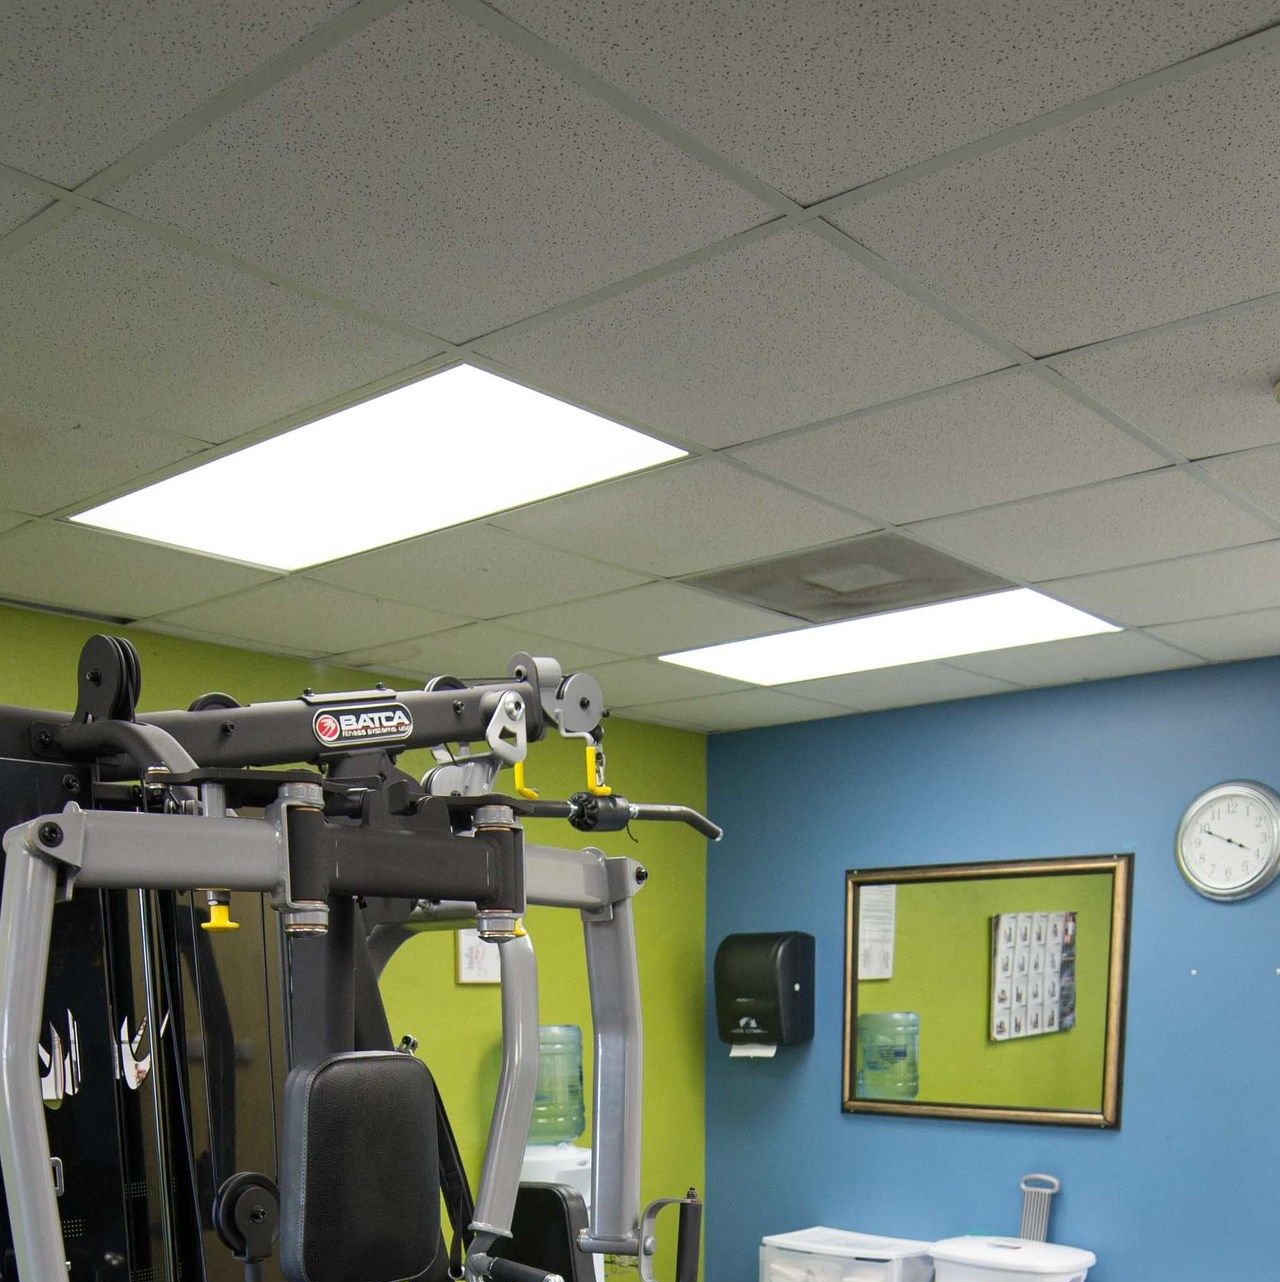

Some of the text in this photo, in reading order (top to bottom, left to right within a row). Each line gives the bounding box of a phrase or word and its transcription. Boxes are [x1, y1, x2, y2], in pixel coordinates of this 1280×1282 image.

[339, 710, 410, 731] BATCA
[1211, 808, 1221, 820] 11
[1227, 802, 1239, 814] 12
[1245, 805, 1251, 817] 1
[1255, 816, 1263, 828] 2
[1194, 839, 1202, 849] 9
[1261, 832, 1268, 844] 3
[1198, 853, 1206, 864] 8
[1210, 863, 1217, 875] 7
[1225, 866, 1232, 878] 6
[1243, 862, 1250, 873] 5
